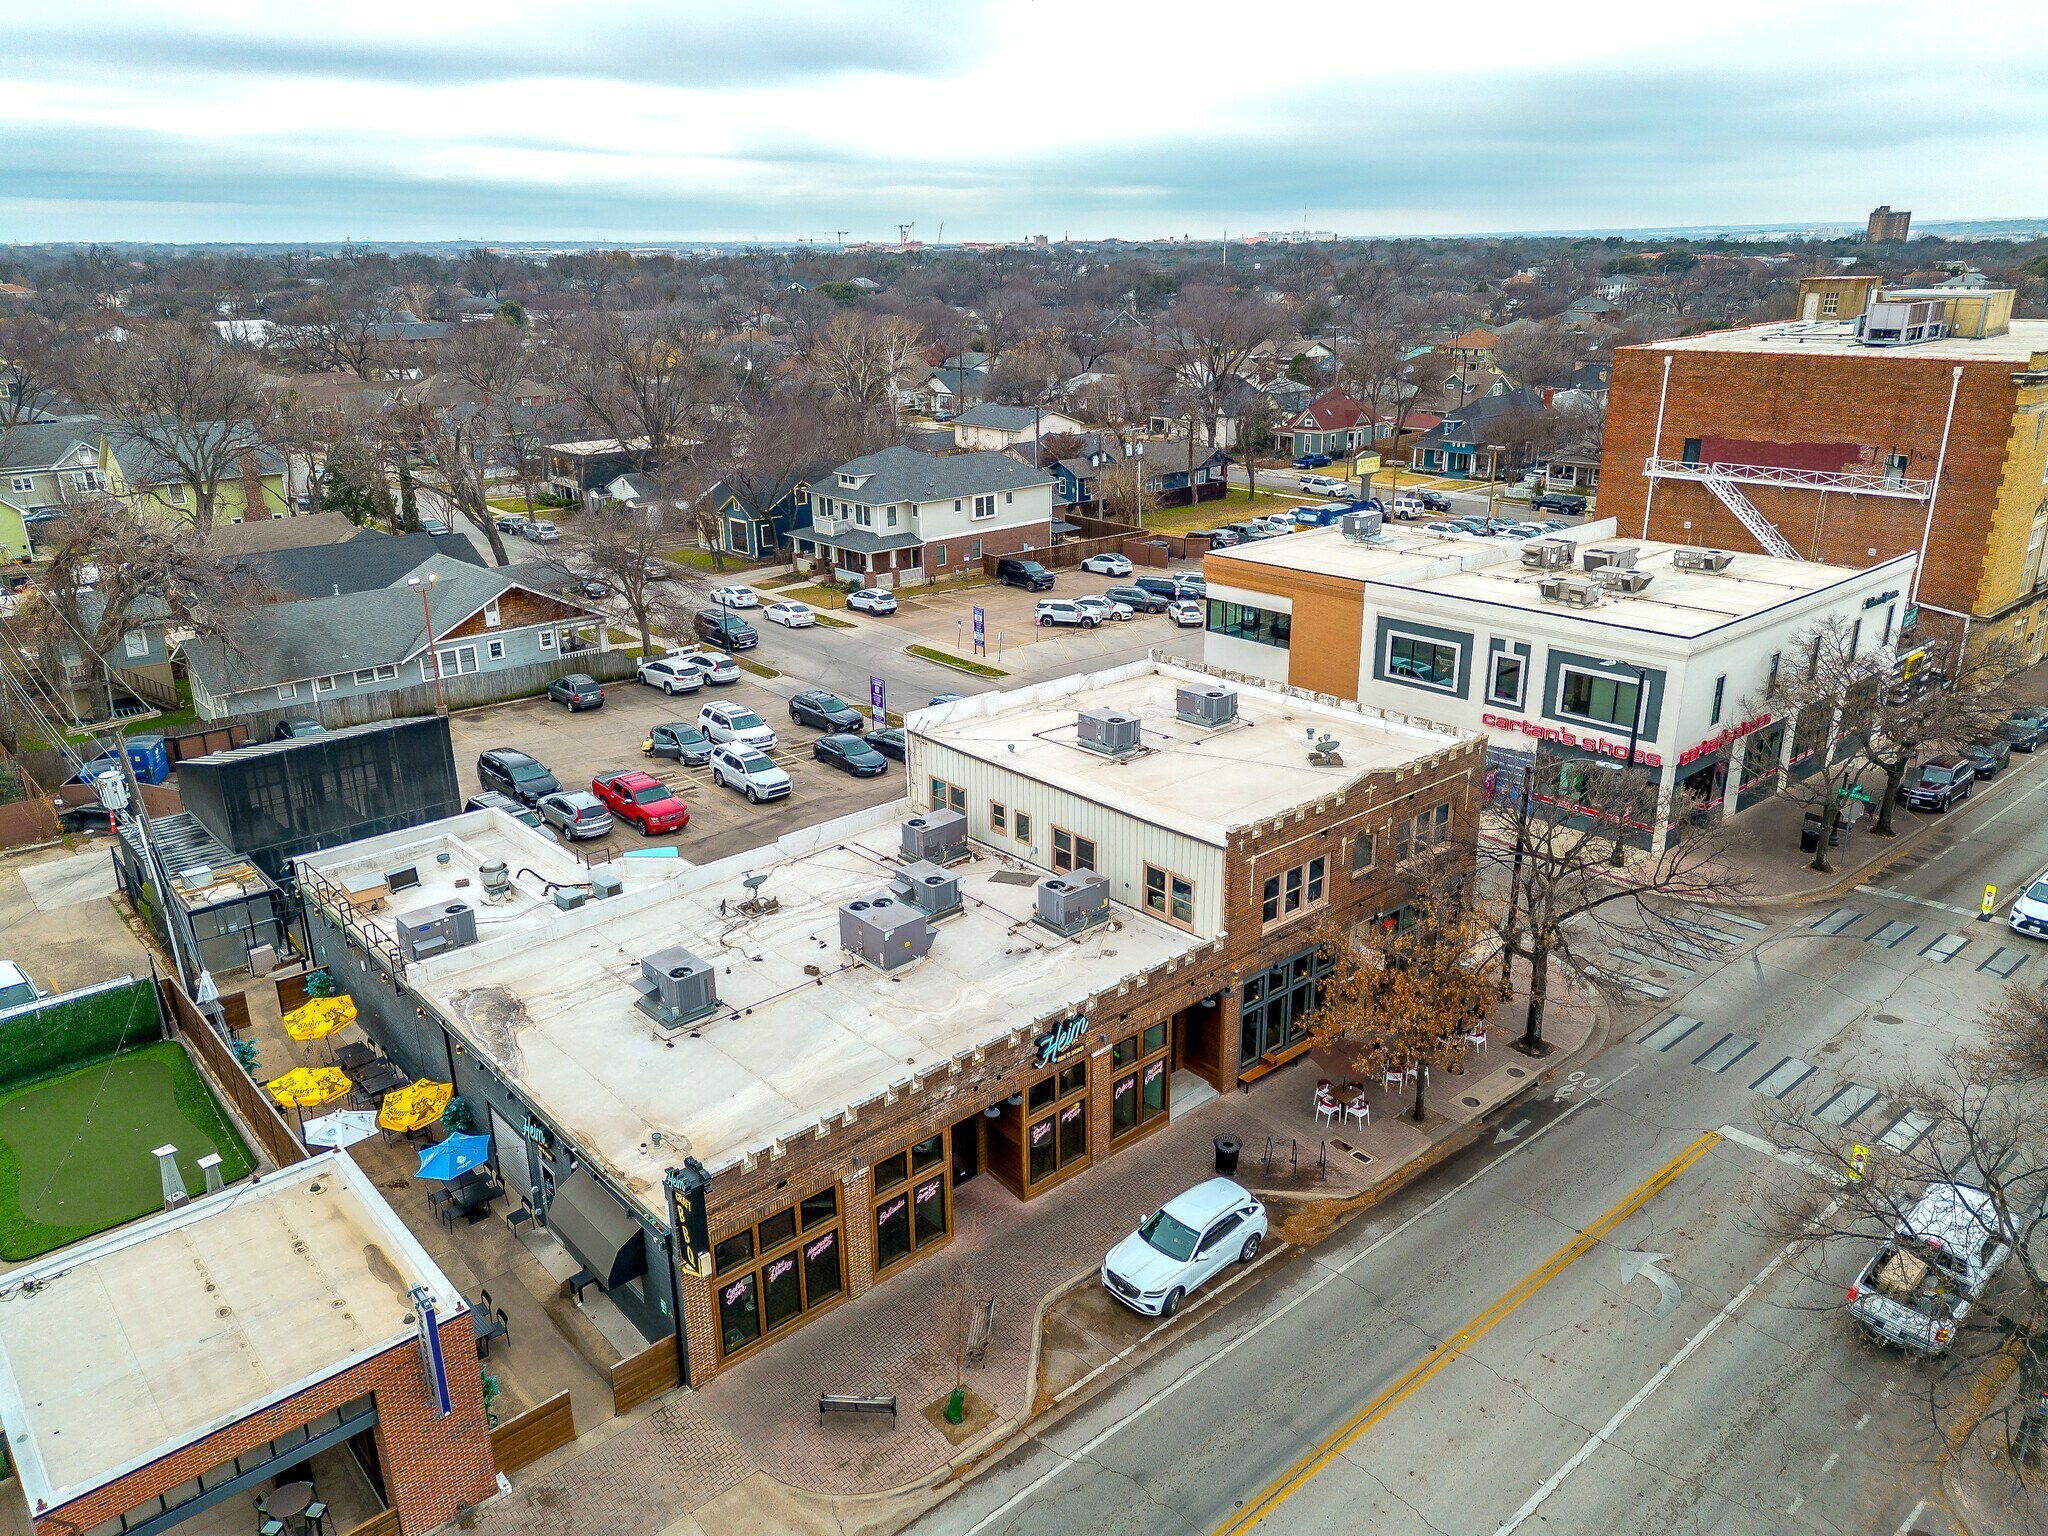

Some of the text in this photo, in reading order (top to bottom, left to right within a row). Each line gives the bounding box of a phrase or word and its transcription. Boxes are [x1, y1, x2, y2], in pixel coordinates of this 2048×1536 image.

[1482, 713, 1662, 768] cartan's shoes
[1034, 1016, 1088, 1069] Heim
[520, 1114, 546, 1144] Heim
[666, 1170, 685, 1191] Heim
[675, 1192, 691, 1213] CRAFT
[726, 1280, 744, 1299] Cold
